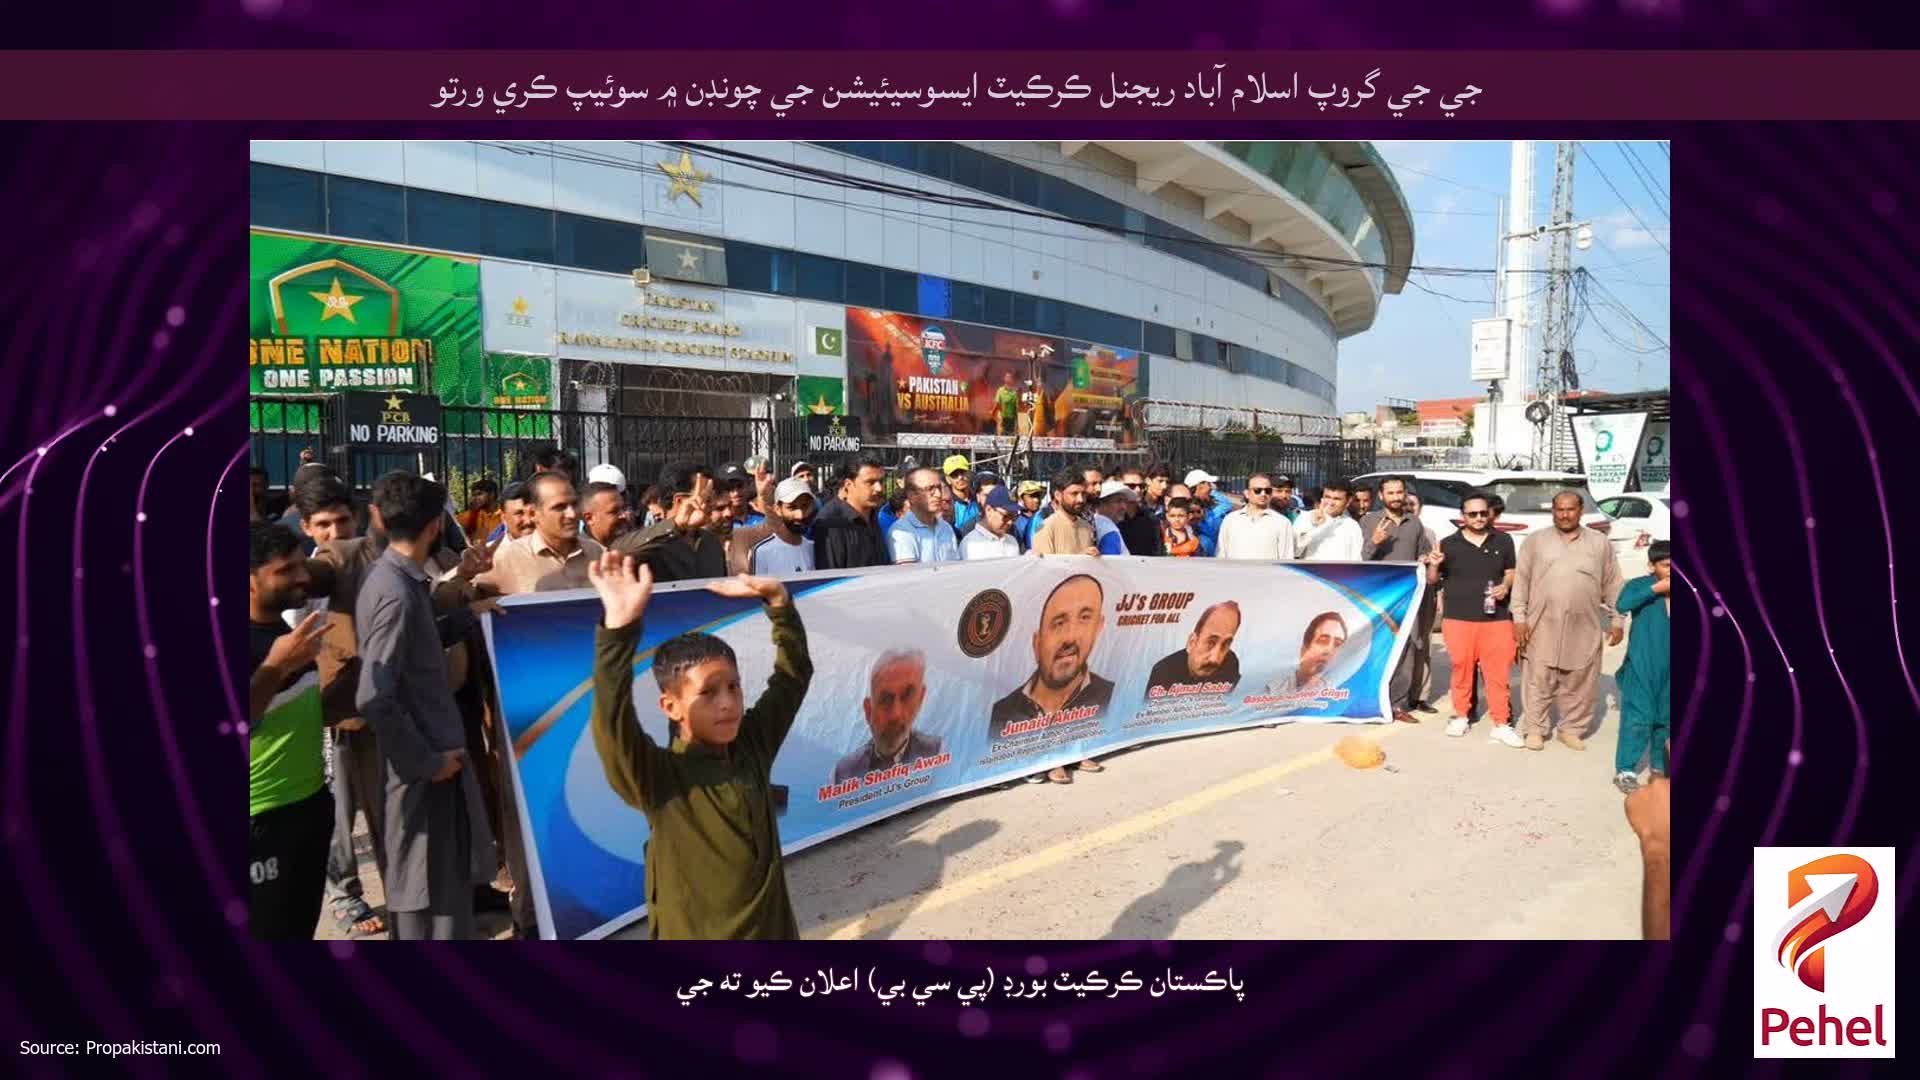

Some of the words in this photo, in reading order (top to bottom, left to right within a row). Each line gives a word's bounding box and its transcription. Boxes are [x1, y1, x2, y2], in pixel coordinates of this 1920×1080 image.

[263, 369, 311, 388] ONE
[319, 367, 414, 387] PASSION
[908, 375, 959, 395] PAKISTAN
[896, 392, 912, 409] VS
[914, 393, 969, 412] AUSTRALIA
[382, 411, 411, 423] PCB
[350, 423, 370, 442] NO
[377, 424, 438, 444] PARKING
[809, 435, 822, 451] NO
[823, 436, 861, 452] PARKING
[1115, 593, 1148, 612] JJ's
[1149, 591, 1195, 611] GROUP
[1168, 611, 1181, 624] ALL
[1001, 712, 1053, 737] Junaid
[1054, 704, 1100, 725] Akhtar
[818, 777, 861, 802] Malik
[863, 765, 910, 787] Shafiq
[913, 752, 952, 772] Awan
